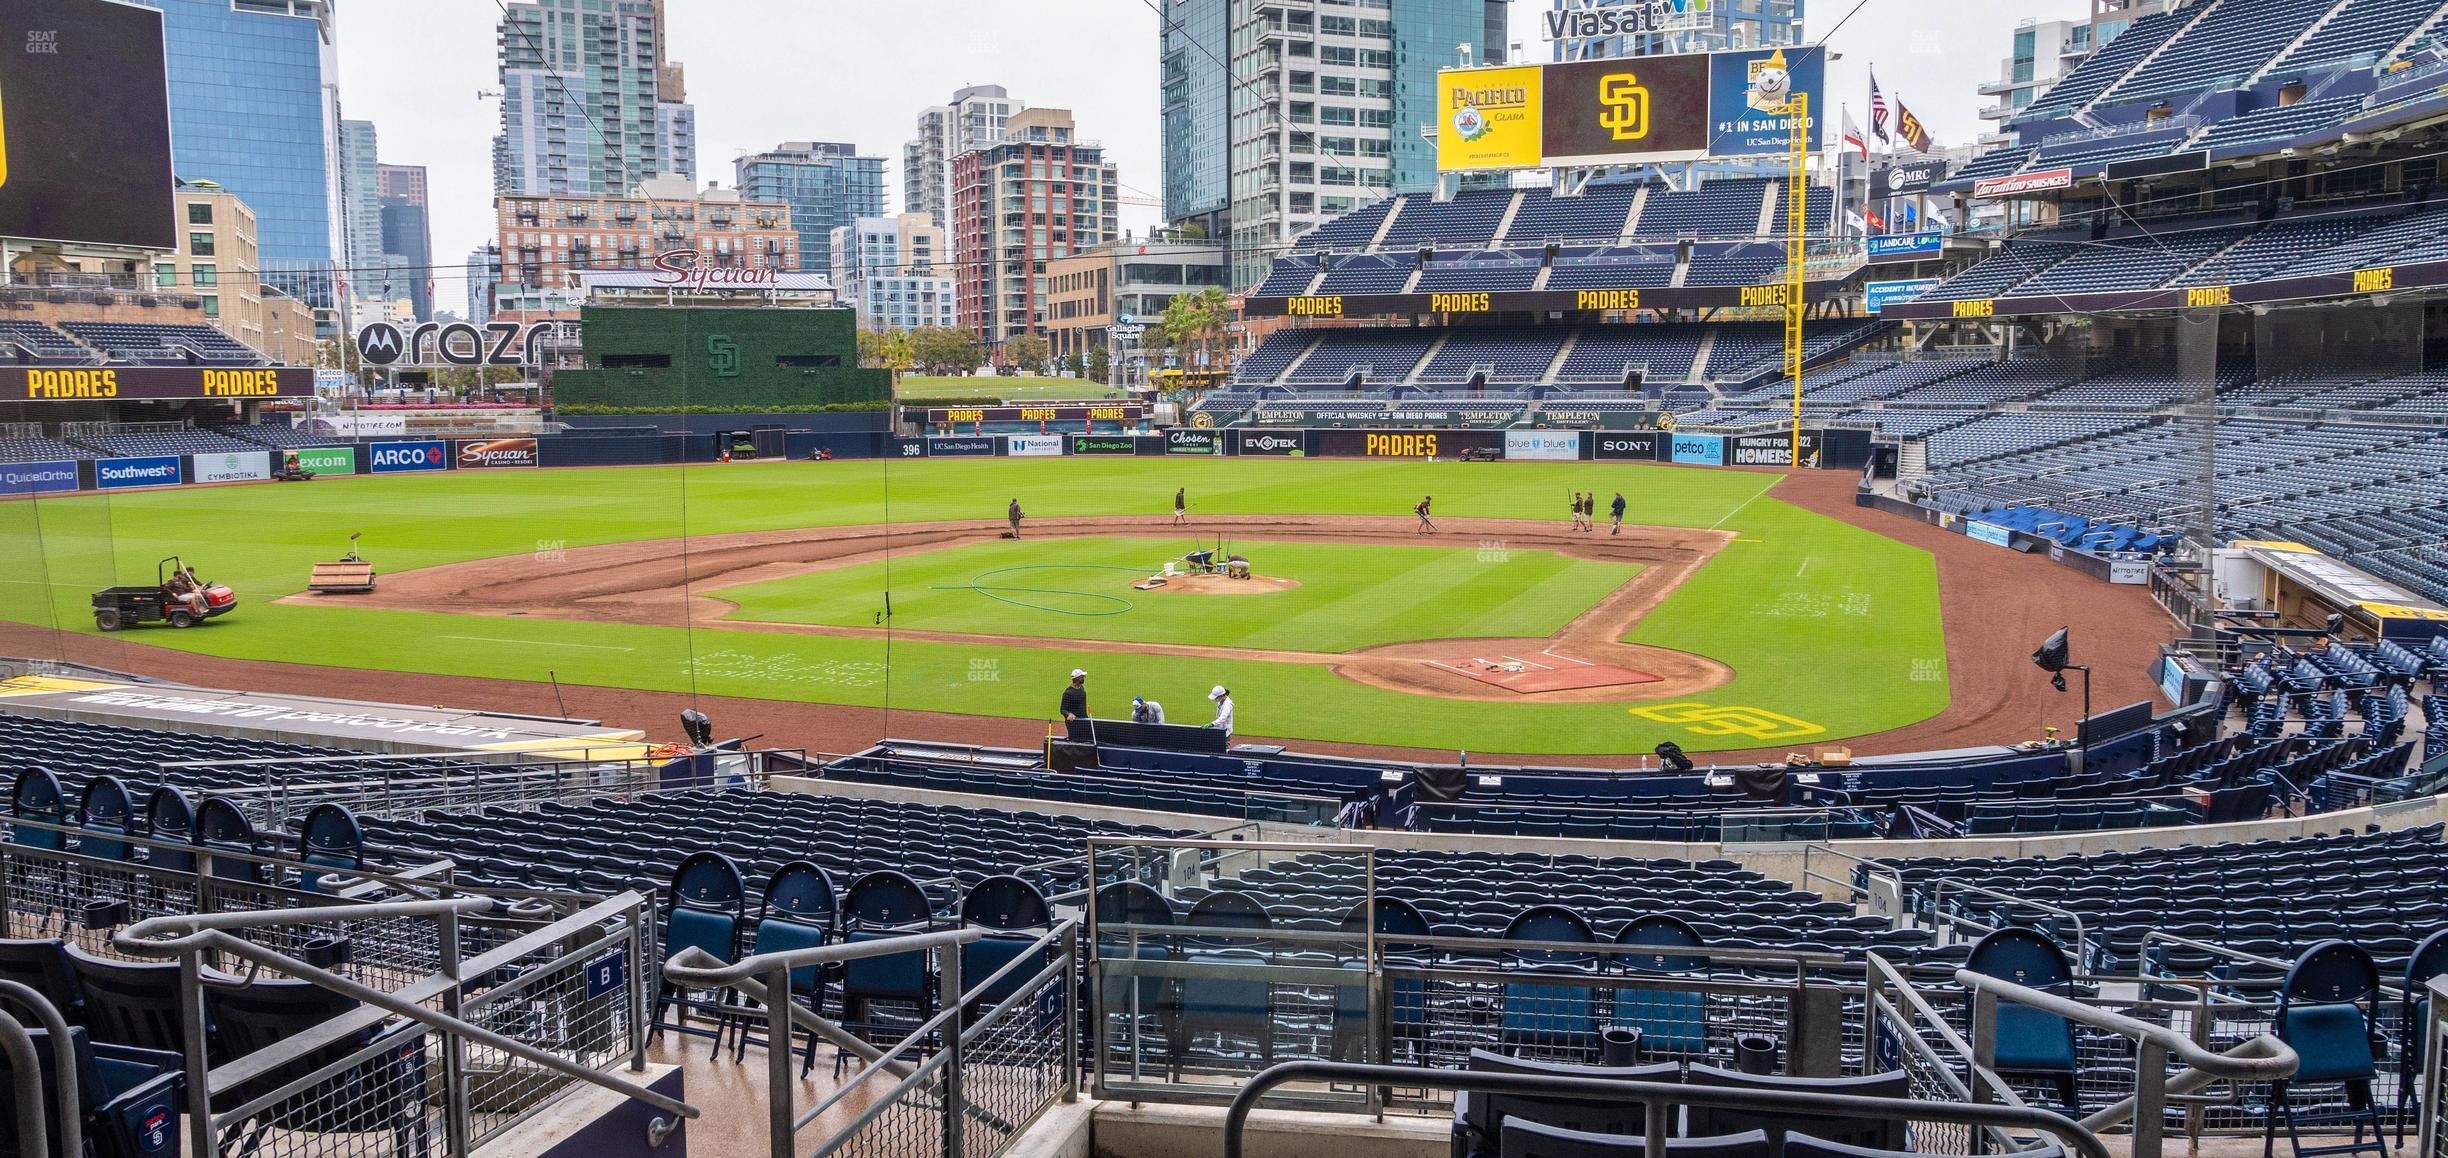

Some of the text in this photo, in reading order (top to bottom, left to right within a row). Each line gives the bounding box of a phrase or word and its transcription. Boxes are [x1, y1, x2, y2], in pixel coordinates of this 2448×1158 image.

[1546, 2, 1658, 39] Viasat
[1453, 87, 1526, 109] PACIFICO
[1600, 73, 1649, 140] SD
[1494, 112, 1525, 122] CLARA
[1719, 121, 1733, 133] #1
[1737, 120, 1749, 132] IN
[1753, 118, 1776, 132] SAN
[1746, 138, 1757, 146] UC
[1771, 136, 1791, 146] Diego
[1905, 169, 1930, 182] MRC
[1977, 176, 2068, 196] Tarantino SAUSAGES
[1880, 237, 1915, 248] LANDCARE
[653, 248, 781, 295] Sycuan
[2353, 267, 2393, 292] PADRES
[1432, 292, 1490, 313] PADRES
[1578, 290, 1639, 310] PADRES
[1741, 285, 1787, 306] PADRES
[2187, 286, 2231, 307] PADRES
[1288, 297, 1342, 315] PADRES
[1953, 300, 1993, 317] PADRES
[1105, 324, 1146, 334] Gallagher
[1111, 332, 1140, 341] Square
[410, 321, 553, 365] razr
[708, 335, 742, 377] SD
[28, 369, 117, 398] PADRES
[203, 369, 277, 396] PADRES
[948, 410, 984, 421] PADRES
[1021, 409, 1056, 420] PADRES
[1091, 408, 1124, 419] PADRES
[1256, 411, 1305, 420] TEMPLETON
[1316, 412, 1346, 420] OFFICIAL
[1347, 412, 1377, 420] WHISKEY
[1392, 412, 1405, 420] SAN
[1406, 412, 1423, 420] DIEGO
[1424, 412, 1448, 420] PADRES
[1459, 411, 1512, 421] TEMPLETON
[1546, 412, 1600, 421] TEMPLETON
[1028, 439, 1059, 448] National
[1170, 431, 1211, 444] Chosen
[1245, 436, 1297, 451] EVOTEK
[1366, 434, 1437, 456] PADRES
[1508, 439, 1566, 448] blue blue
[1740, 438, 1789, 448] HUNGRY FOR
[1798, 436, 1811, 448] 322
[902, 444, 920, 456] 396
[955, 443, 971, 451] Diego
[1101, 442, 1120, 450] Diego
[1603, 440, 1652, 451] SONY
[1674, 441, 1705, 456] petco
[373, 449, 426, 466] ARCO
[462, 443, 530, 466] Sycuan
[1735, 448, 1793, 464] HOMERS
[6, 471, 74, 485] QuidelOrtho
[102, 465, 167, 480] Southwest
[207, 472, 259, 481] CYMBIOTIKA
[265, 709, 411, 729] petco
[393, 720, 516, 740] park
[1183, 863, 1196, 883] 104
[1874, 892, 1887, 913] 104
[601, 966, 610, 986] B
[1047, 994, 1055, 1015] C
[1884, 1037, 1891, 1059] C
